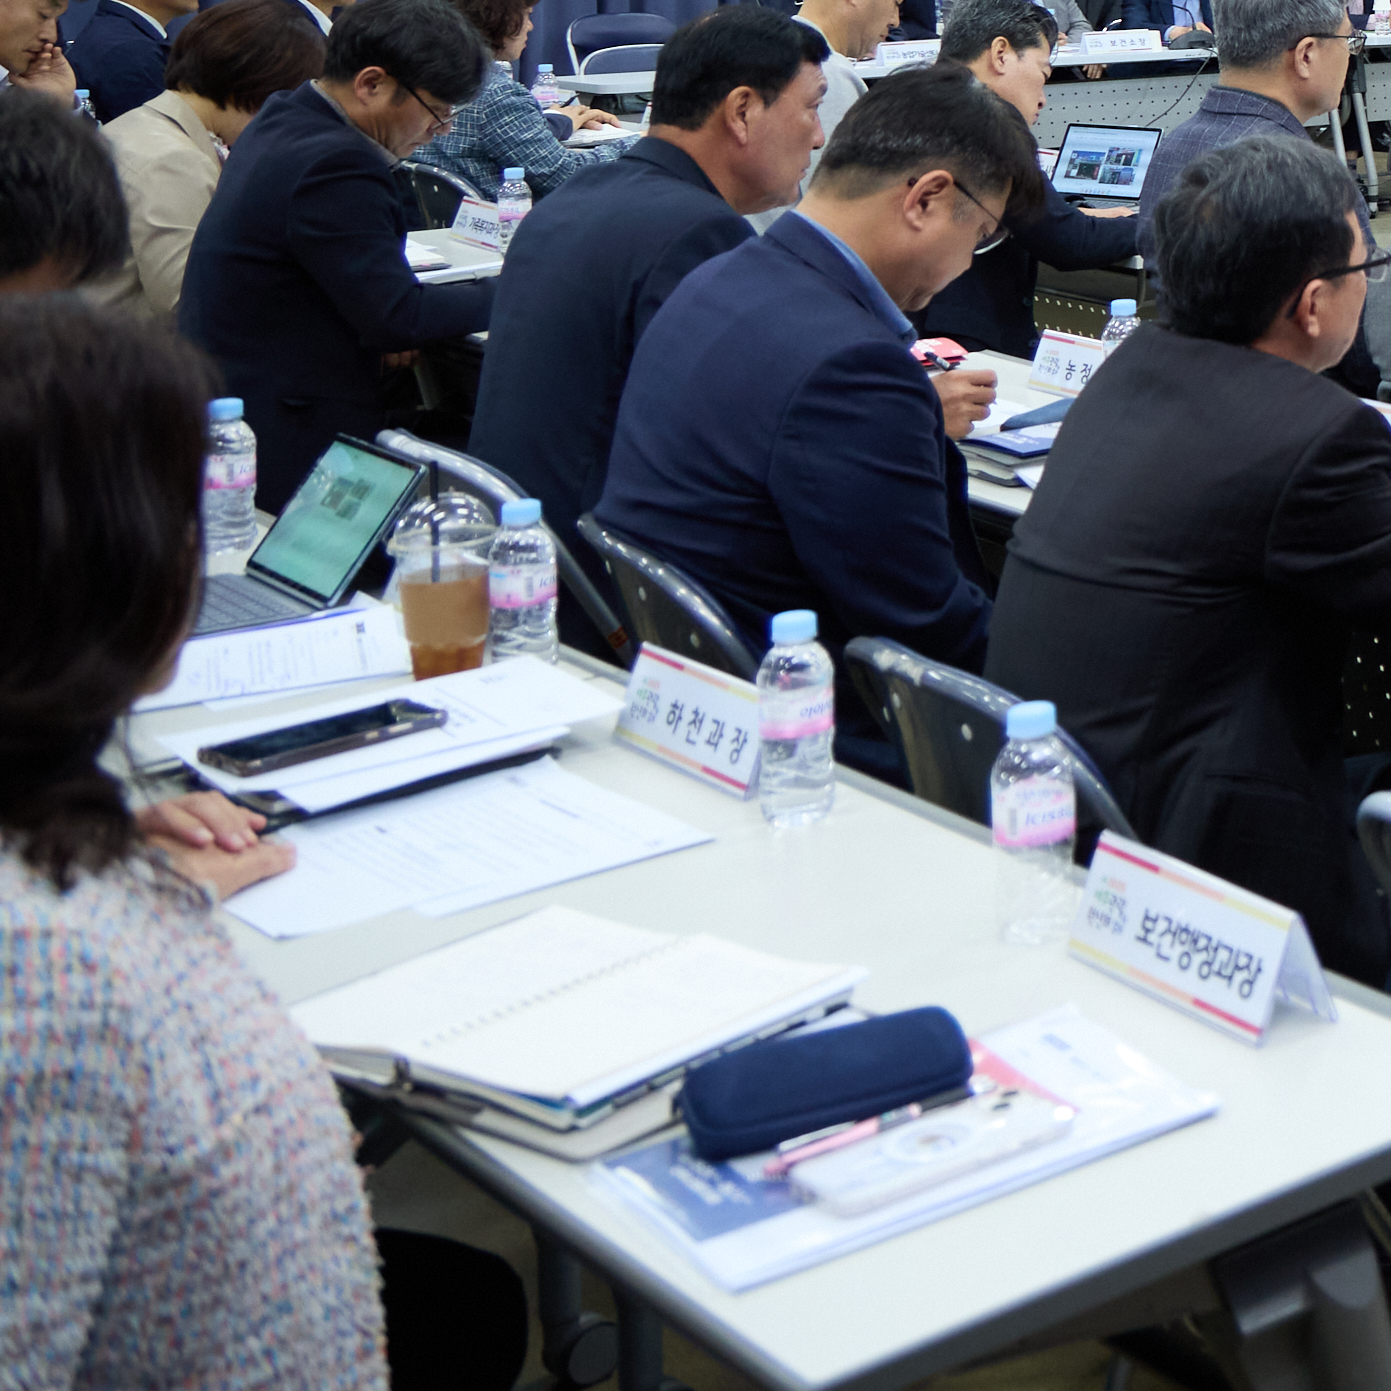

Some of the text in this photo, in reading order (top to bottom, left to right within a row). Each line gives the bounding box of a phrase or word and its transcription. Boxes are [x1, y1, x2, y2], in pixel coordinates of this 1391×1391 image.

[902, 49, 938, 59] 농업기술센터
[1110, 37, 1146, 48] 보건소장
[1065, 360, 1092, 385] 농정
[666, 699, 748, 765] 하천과장
[1135, 909, 1263, 999] 보건행정과장
